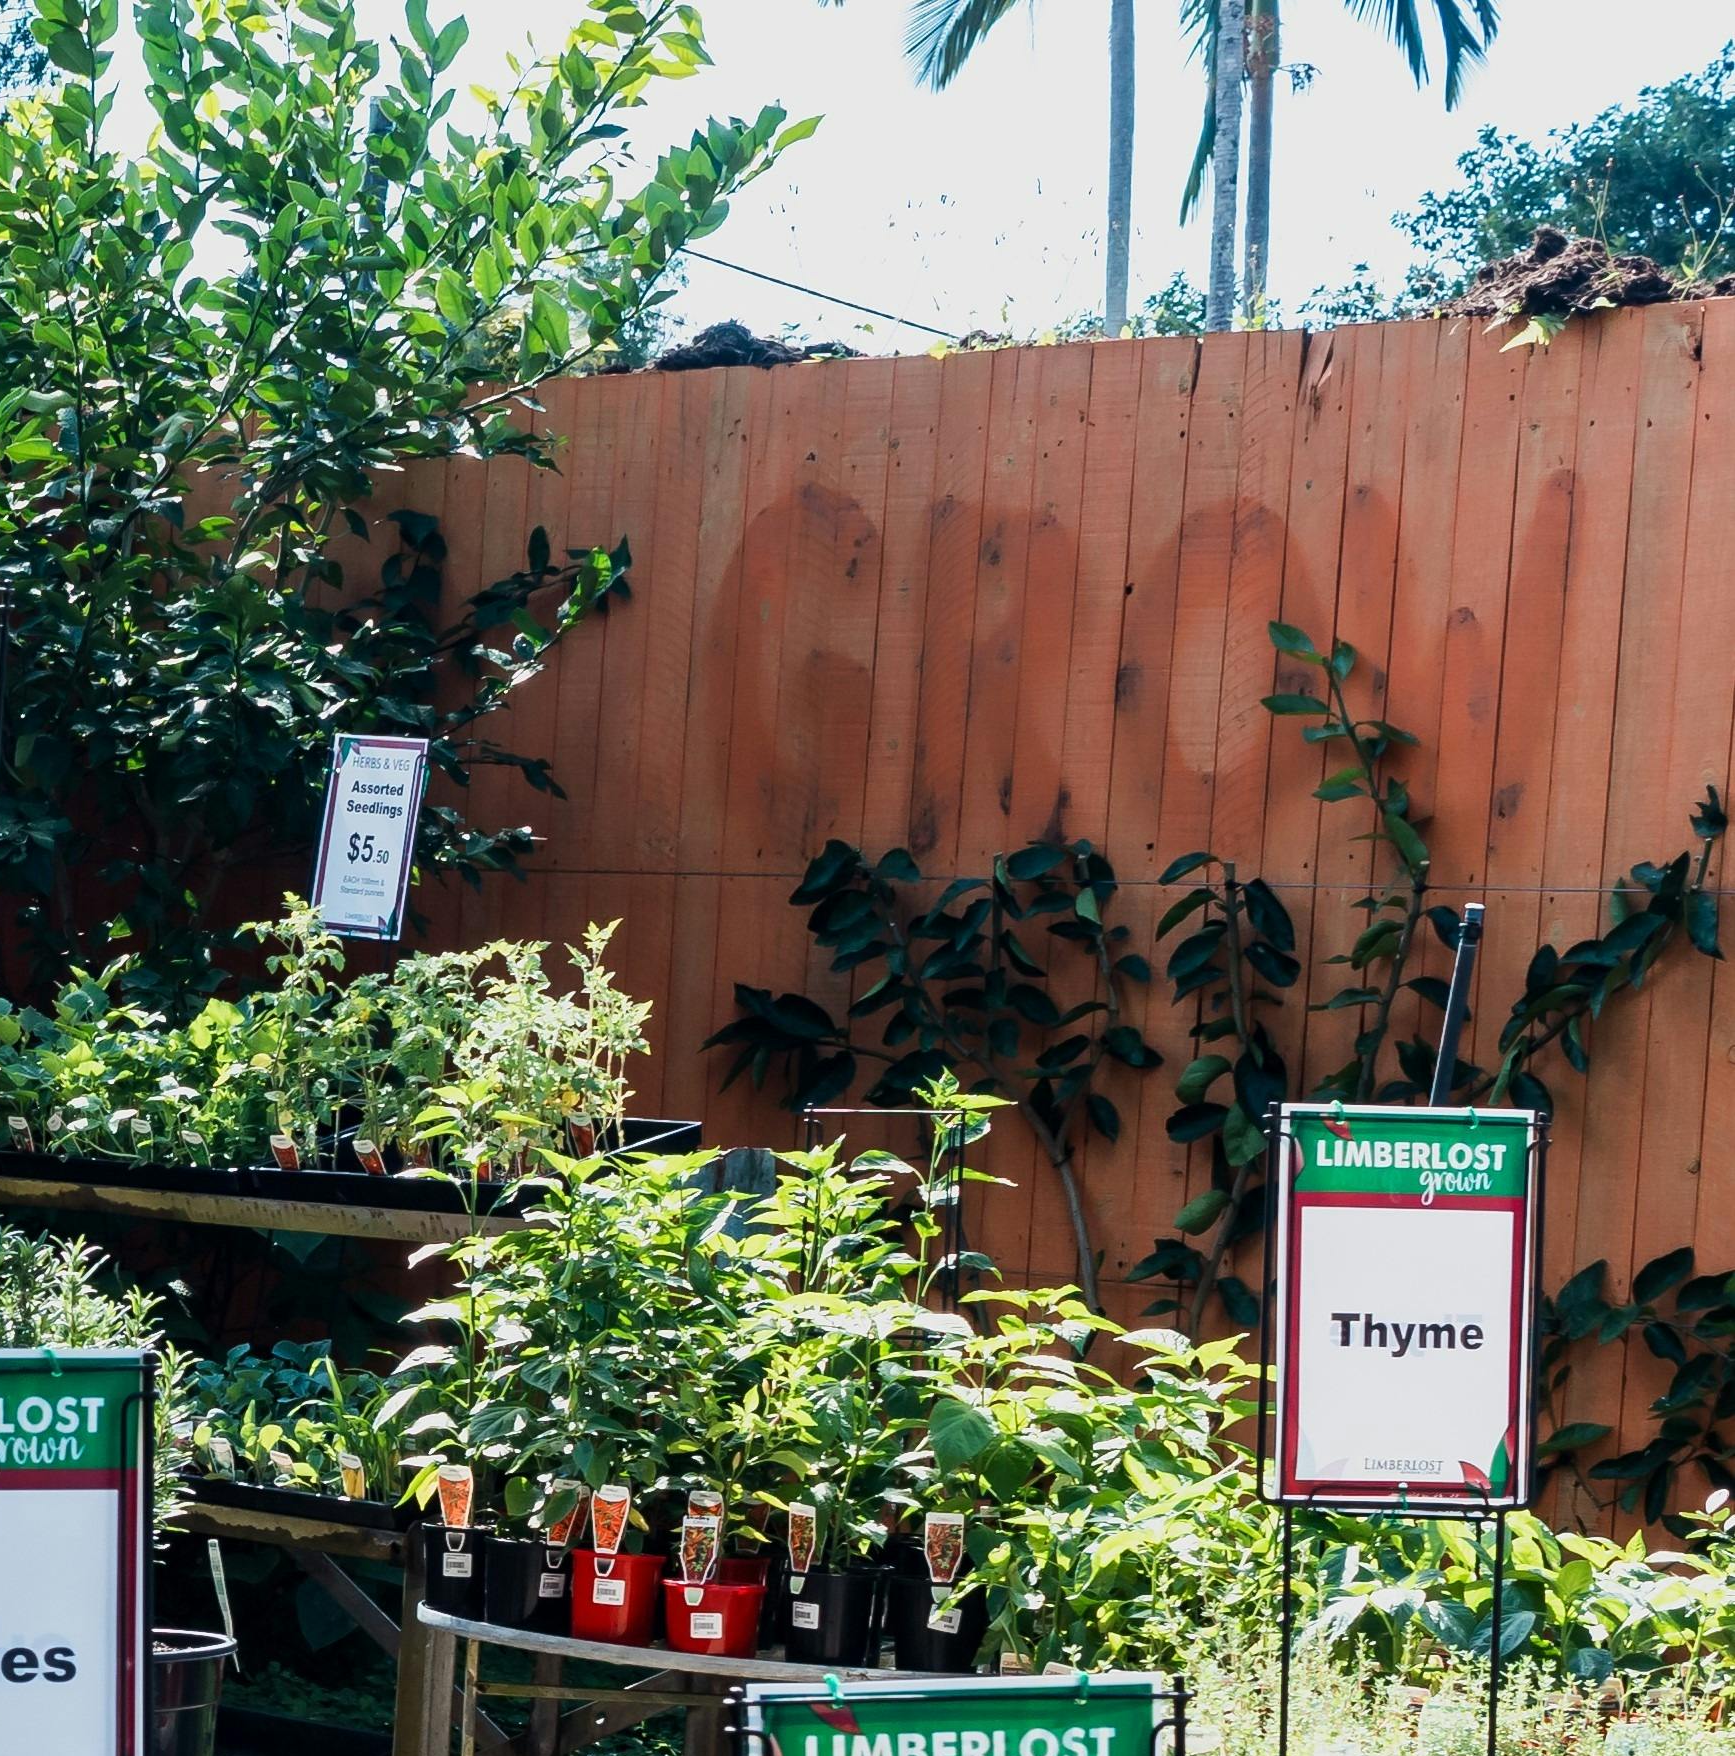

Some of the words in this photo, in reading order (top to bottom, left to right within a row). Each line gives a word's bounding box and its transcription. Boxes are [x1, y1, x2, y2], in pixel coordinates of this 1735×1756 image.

[352, 756, 380, 768] HERBS
[383, 757, 389, 768] &
[392, 759, 409, 771] VEG
[351, 780, 403, 795] Assorted
[347, 800, 402, 818] Seedlings
[347, 832, 389, 865] $5.50
[1316, 1139, 1507, 1170] LIMBERLOST
[1419, 1170, 1493, 1206] grown
[1331, 1312, 1484, 1357] Thyme
[1364, 1457, 1443, 1472] LIMBERLOST
